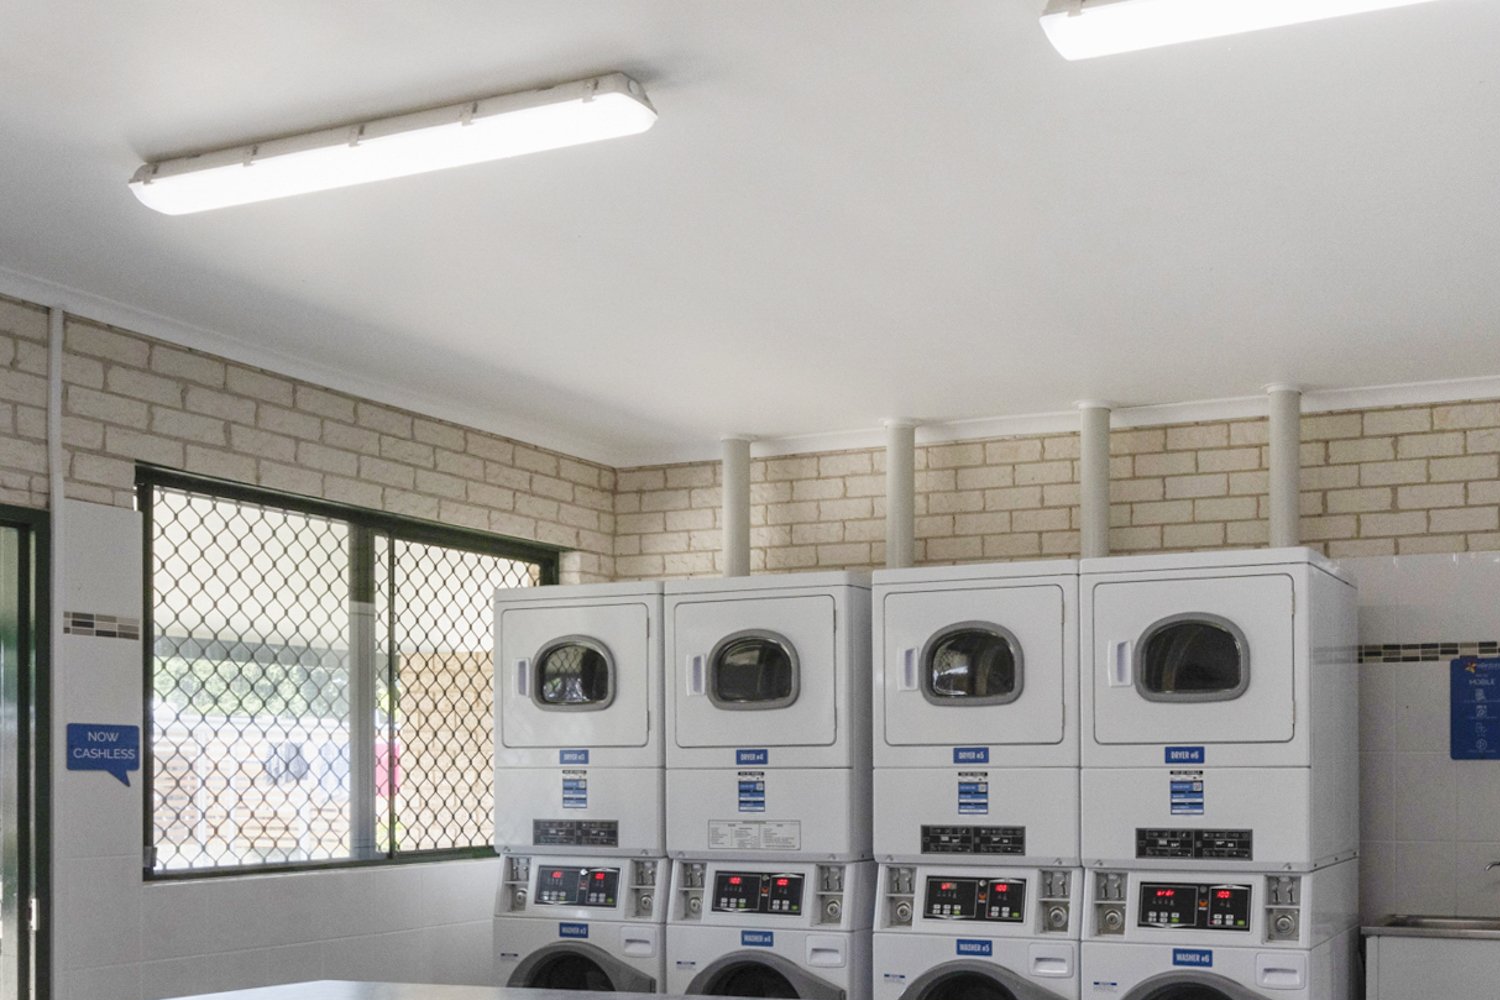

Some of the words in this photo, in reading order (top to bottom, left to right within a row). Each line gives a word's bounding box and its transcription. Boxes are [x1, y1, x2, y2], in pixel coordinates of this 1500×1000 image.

[88, 731, 119, 743] NOW
[73, 747, 136, 760] CASHLESS
[1171, 751, 1189, 760] DRYER
[1176, 953, 1200, 963] WASHER
